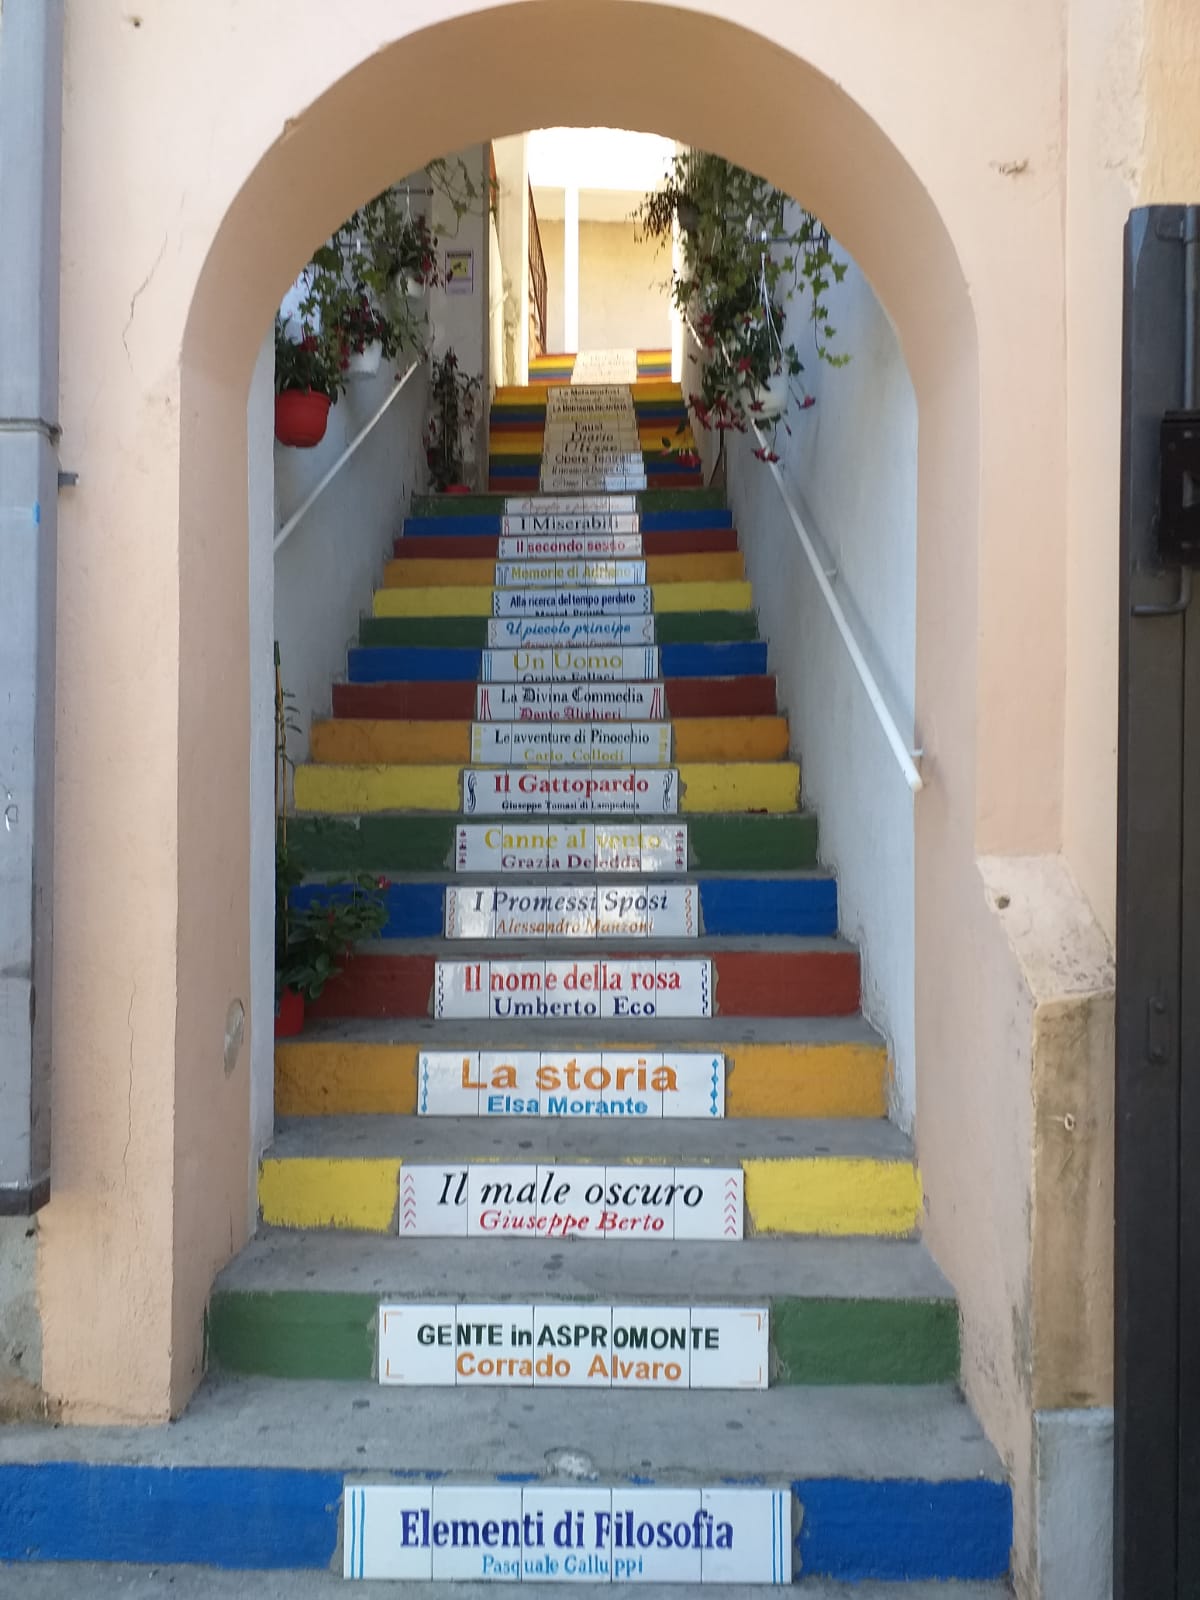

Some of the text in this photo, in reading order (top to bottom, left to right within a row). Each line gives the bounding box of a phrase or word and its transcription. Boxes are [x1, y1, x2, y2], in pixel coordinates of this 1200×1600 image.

[521, 515, 619, 531] I Miserabili
[517, 538, 625, 553] Il secondo sesso
[511, 563, 631, 580] Memorie di Adriano
[510, 591, 636, 608] Alla ricerca del tempo perduto
[522, 619, 570, 641] piccolo
[571, 620, 631, 640] principe
[513, 651, 623, 671] Un Uomo
[501, 685, 643, 703] La Divina Commedia
[495, 727, 649, 744] Le avventure di Pinocchio
[524, 750, 624, 761] Carlo Collodi
[494, 773, 649, 798] Il Gattopardo
[502, 800, 542, 814] Giuseppe
[545, 800, 577, 810] Tomasi
[580, 799, 588, 809] di
[484, 827, 662, 850] Canne al vento
[501, 853, 641, 870] Grazia Deledda
[473, 889, 670, 918] I Promessi Sposi
[496, 917, 655, 934] Alessandro Manzoni
[464, 962, 682, 992] Il nome della rosa
[494, 995, 656, 1017] Umberto Eco
[461, 1057, 679, 1092] La storia
[487, 1095, 649, 1115] Elsa Morante
[436, 1171, 704, 1208] Il male oscuro
[479, 1208, 665, 1238] Giuseppe Berto
[417, 1324, 720, 1350] GENTE in ASPROMONTE
[456, 1351, 683, 1382] Corrado Alvaro
[400, 1508, 735, 1552] Elementi di Filosofia
[482, 1553, 644, 1580] Pasquale Galluppi
